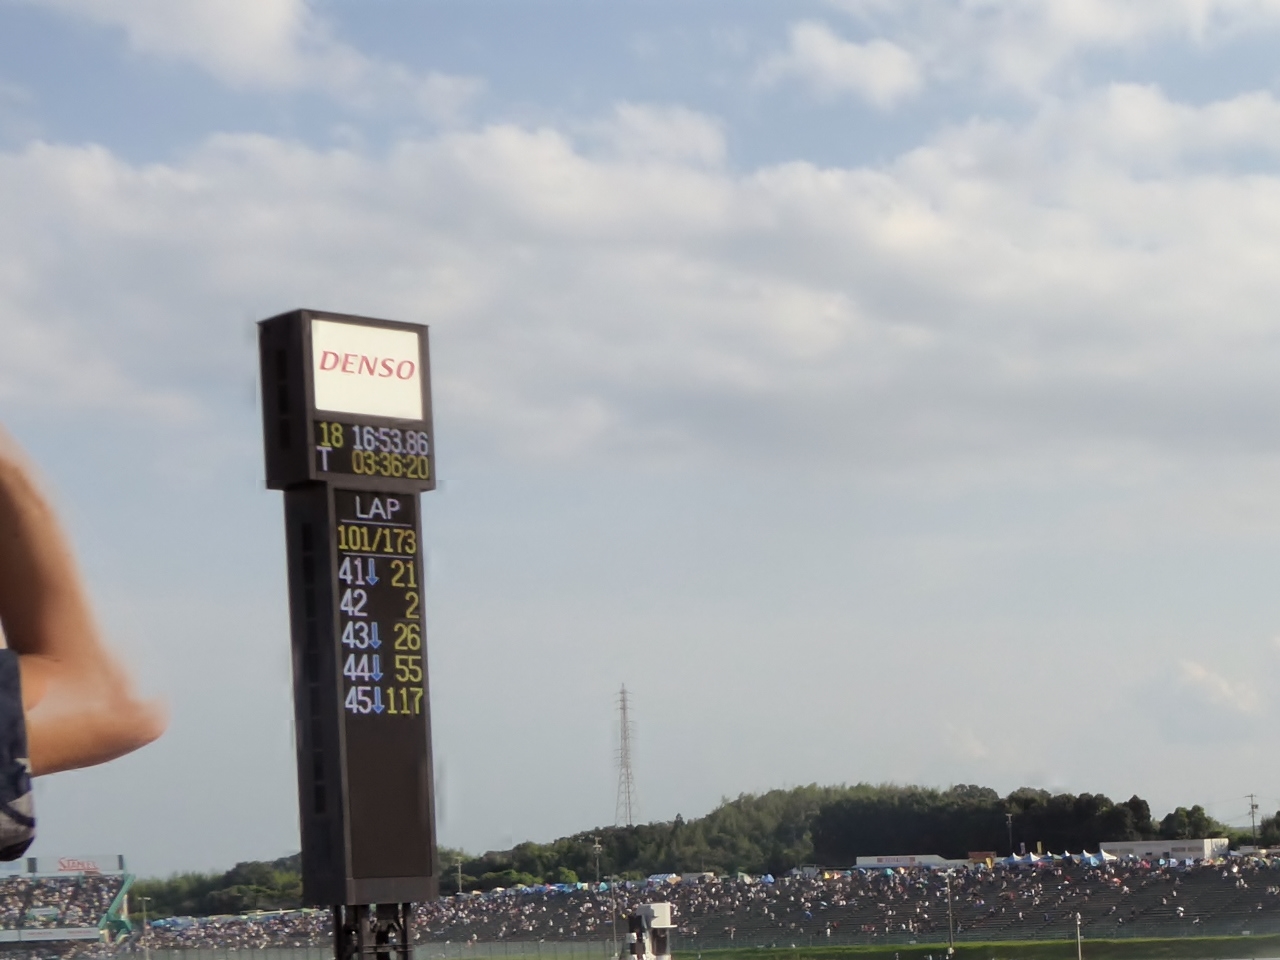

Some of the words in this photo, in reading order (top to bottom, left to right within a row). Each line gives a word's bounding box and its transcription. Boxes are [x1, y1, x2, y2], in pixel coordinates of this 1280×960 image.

[319, 350, 416, 380] DENSO
[320, 421, 344, 448] 18
[352, 425, 429, 456] 16:53.86
[316, 445, 333, 471] T
[352, 450, 429, 479] 03:36:20
[355, 496, 400, 520] LAP
[338, 525, 416, 554] 101/173
[338, 556, 366, 586] 41
[390, 559, 417, 587] 21
[340, 588, 368, 617] 42
[405, 591, 420, 619] 2
[341, 621, 369, 649] 43
[393, 623, 421, 650] 26
[343, 653, 370, 682] 44
[394, 655, 423, 682] 55
[345, 686, 372, 714] 45
[387, 686, 424, 714] 117
